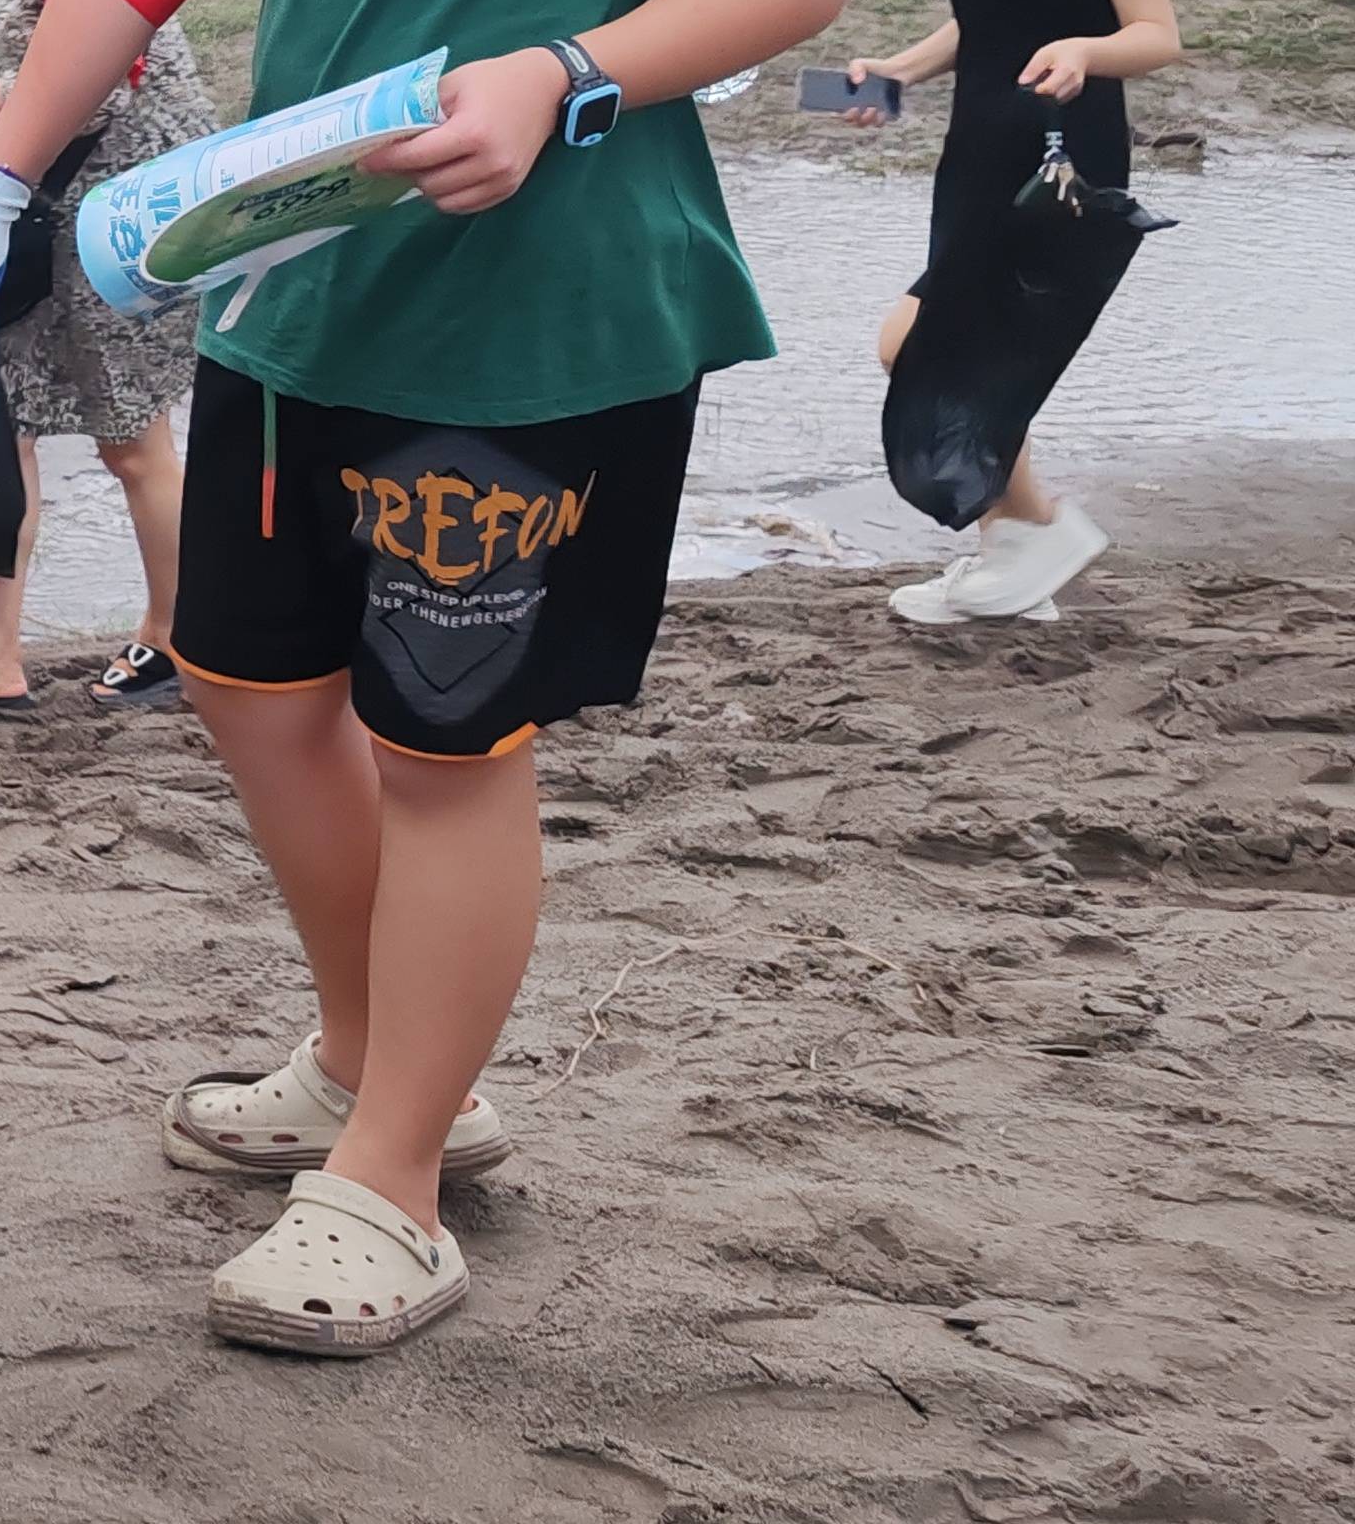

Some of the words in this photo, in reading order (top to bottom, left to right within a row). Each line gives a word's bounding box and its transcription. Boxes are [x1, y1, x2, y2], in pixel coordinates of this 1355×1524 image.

[387, 581, 418, 595] ONE
[420, 588, 459, 606] STEP
[462, 594, 482, 607] UP
